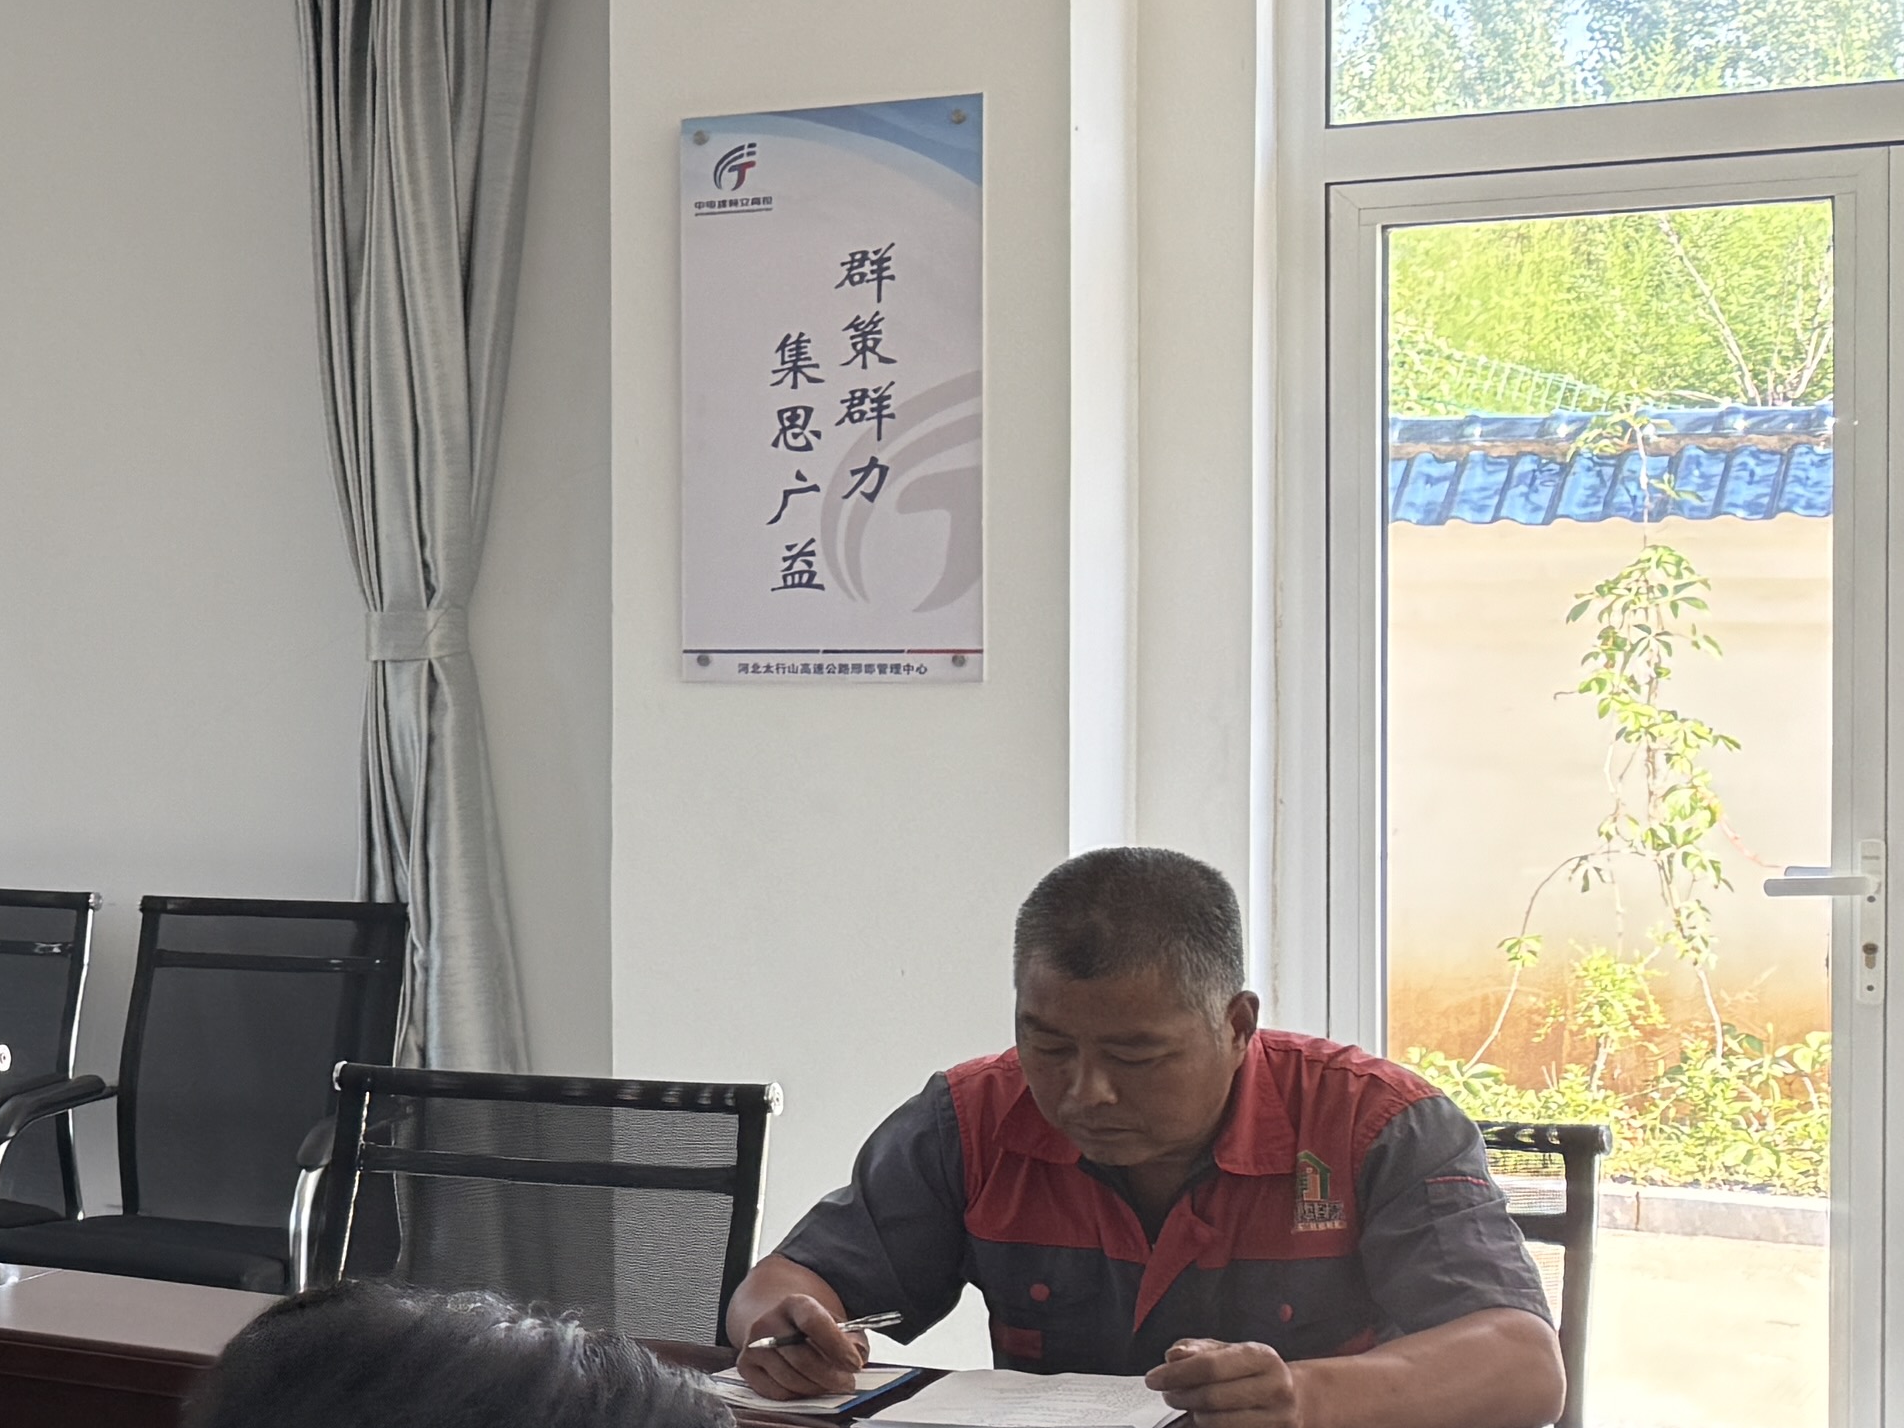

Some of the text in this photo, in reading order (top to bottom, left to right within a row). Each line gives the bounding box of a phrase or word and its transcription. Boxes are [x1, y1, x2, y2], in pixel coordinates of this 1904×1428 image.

[766, 332, 825, 591] 集思广益
[834, 242, 896, 503] 群策群力
